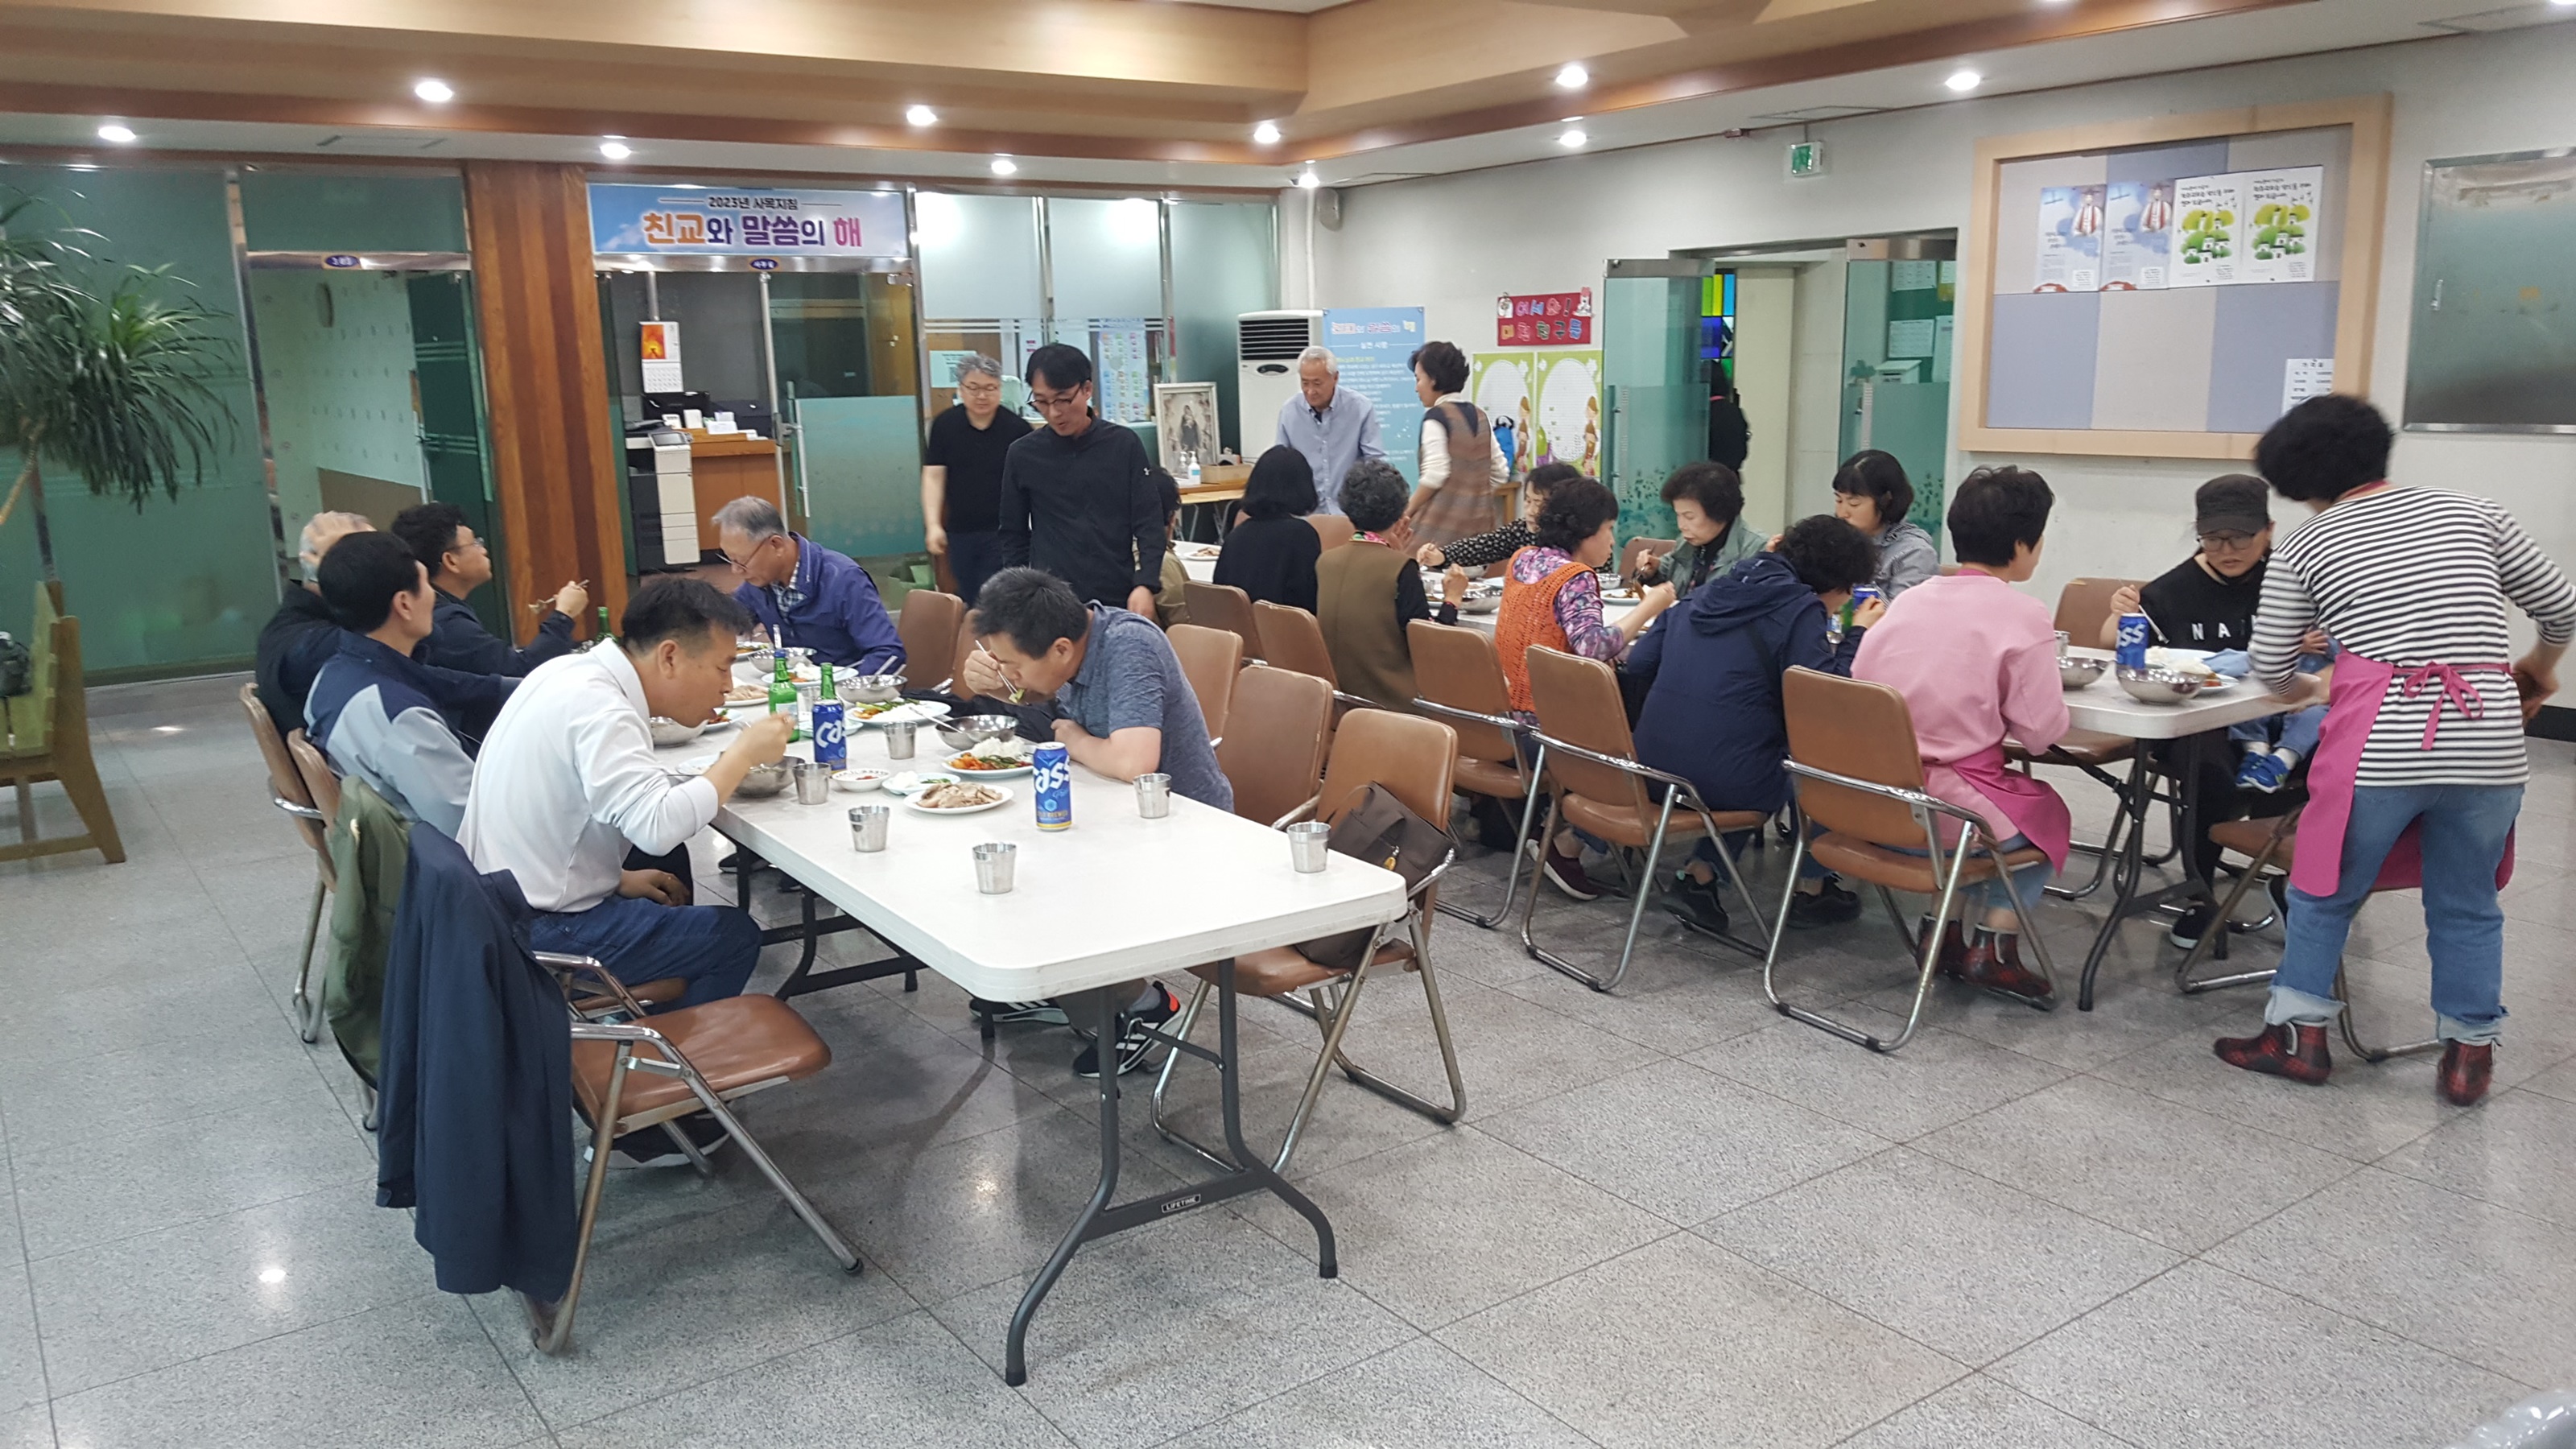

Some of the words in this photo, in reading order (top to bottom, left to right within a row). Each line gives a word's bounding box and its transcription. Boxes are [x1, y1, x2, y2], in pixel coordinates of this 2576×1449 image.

[709, 196, 750, 209] 2023년
[753, 198, 799, 210] 사목지침
[643, 213, 733, 245] 친교와
[742, 215, 825, 246] 말씀의
[833, 217, 862, 247] 해
[1166, 1197, 1196, 1210] LIFETIME
